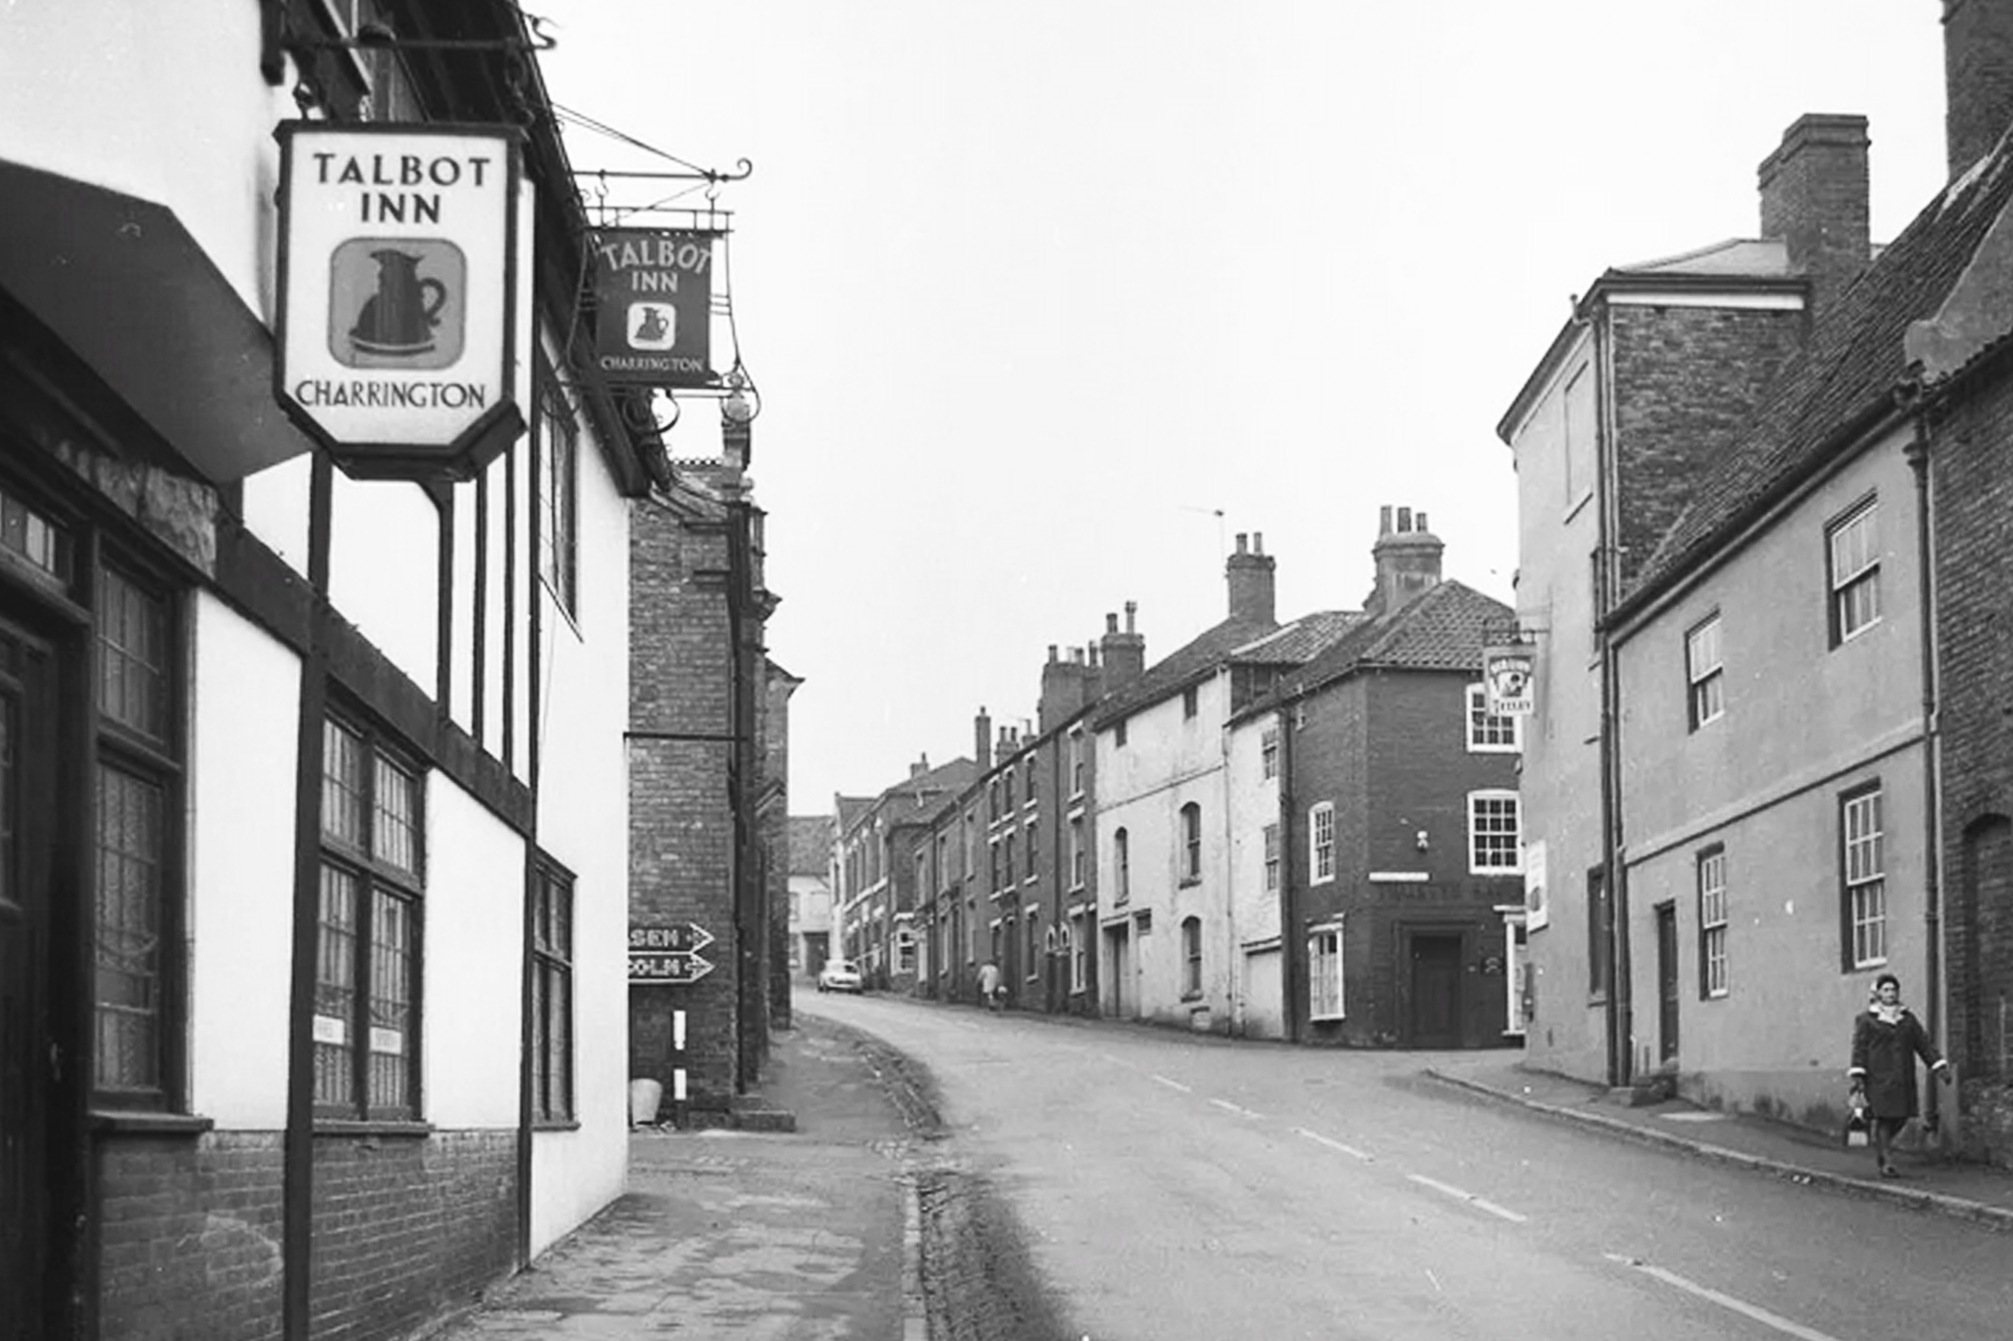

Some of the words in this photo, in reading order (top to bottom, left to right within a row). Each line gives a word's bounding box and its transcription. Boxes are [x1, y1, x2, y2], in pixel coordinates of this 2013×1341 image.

[313, 153, 491, 187] TALBOT
[360, 192, 441, 224] INN
[600, 239, 711, 275] TALBOT
[631, 271, 679, 293] INN
[600, 355, 704, 373] CHARRINGTON
[295, 379, 487, 410] CHARRINGTON
